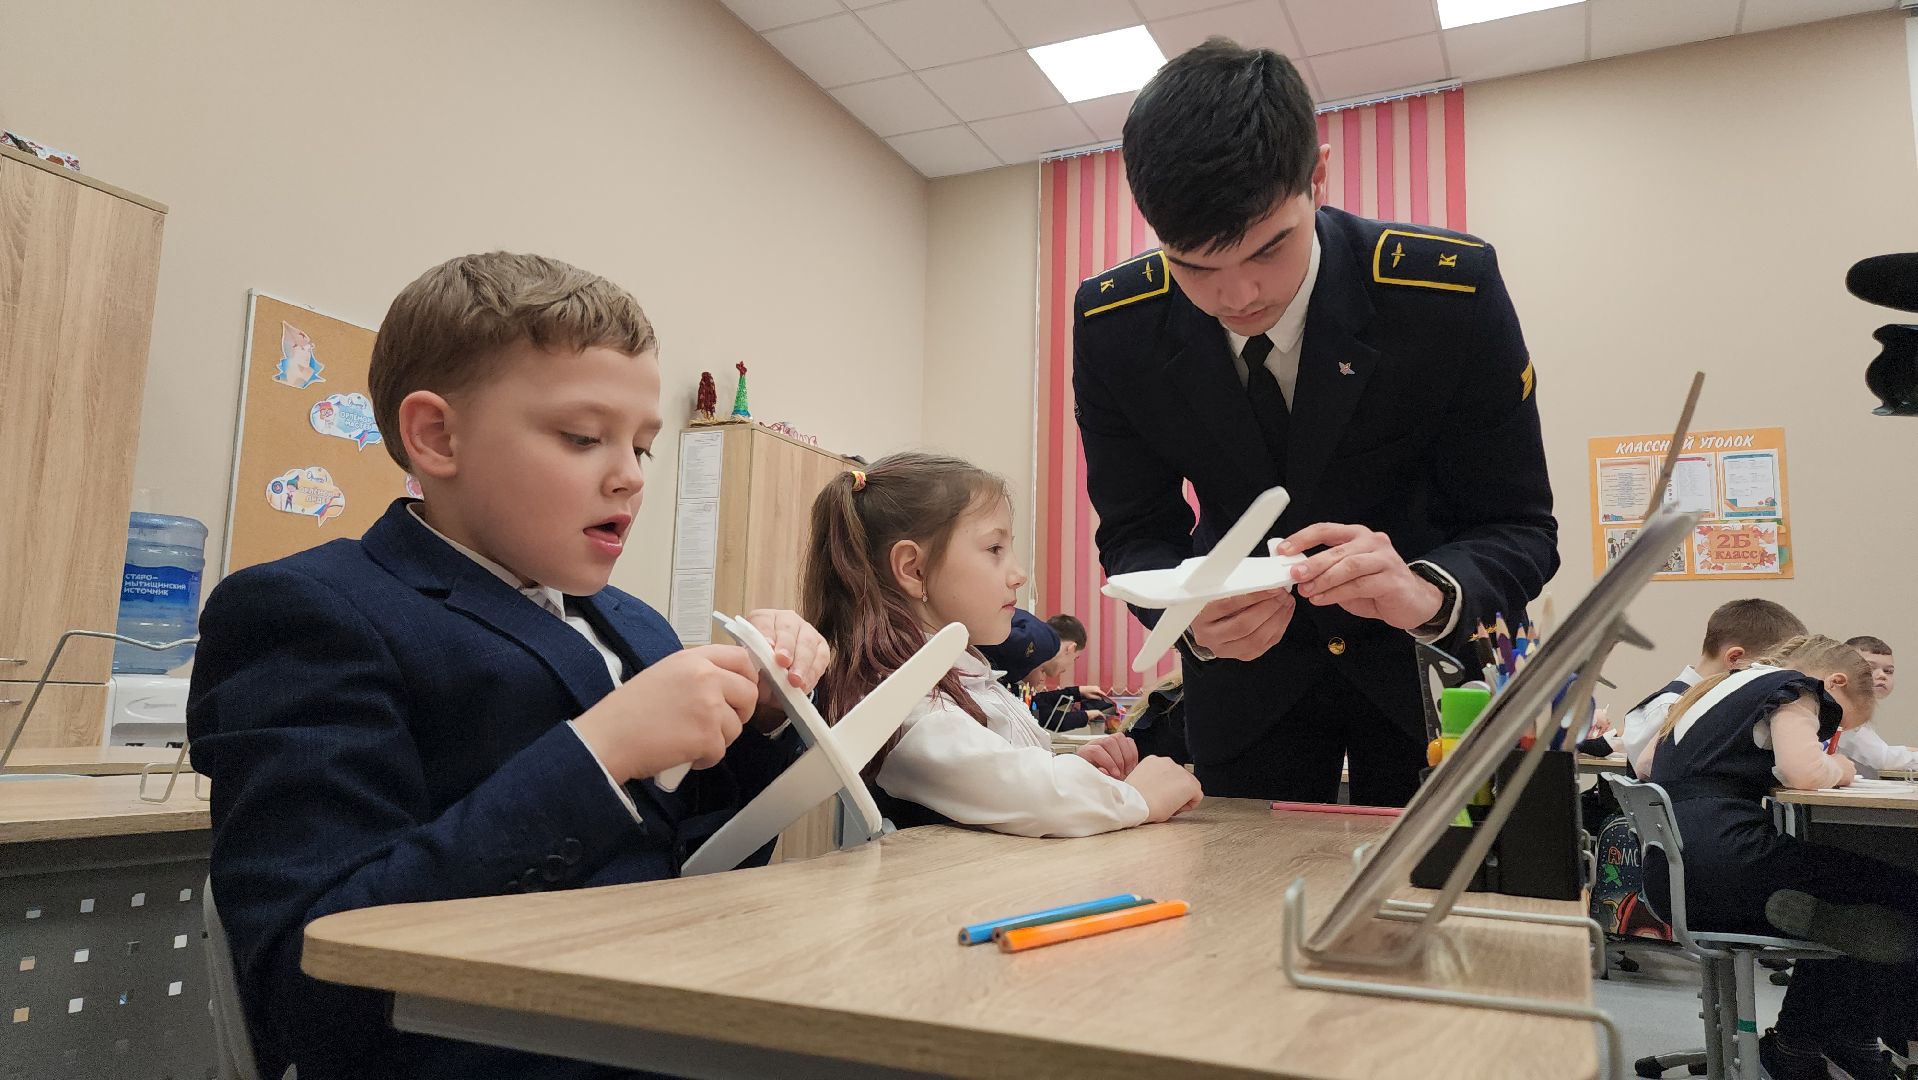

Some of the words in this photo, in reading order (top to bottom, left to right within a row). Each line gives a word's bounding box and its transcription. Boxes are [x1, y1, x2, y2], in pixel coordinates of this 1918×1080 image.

[1615, 436, 1695, 454] КЛАССНЙ
[1699, 434, 1755, 449] УГОЛОК
[1716, 533, 1751, 549] 2Б
[123, 587, 169, 596] ИСТОЧНИК
